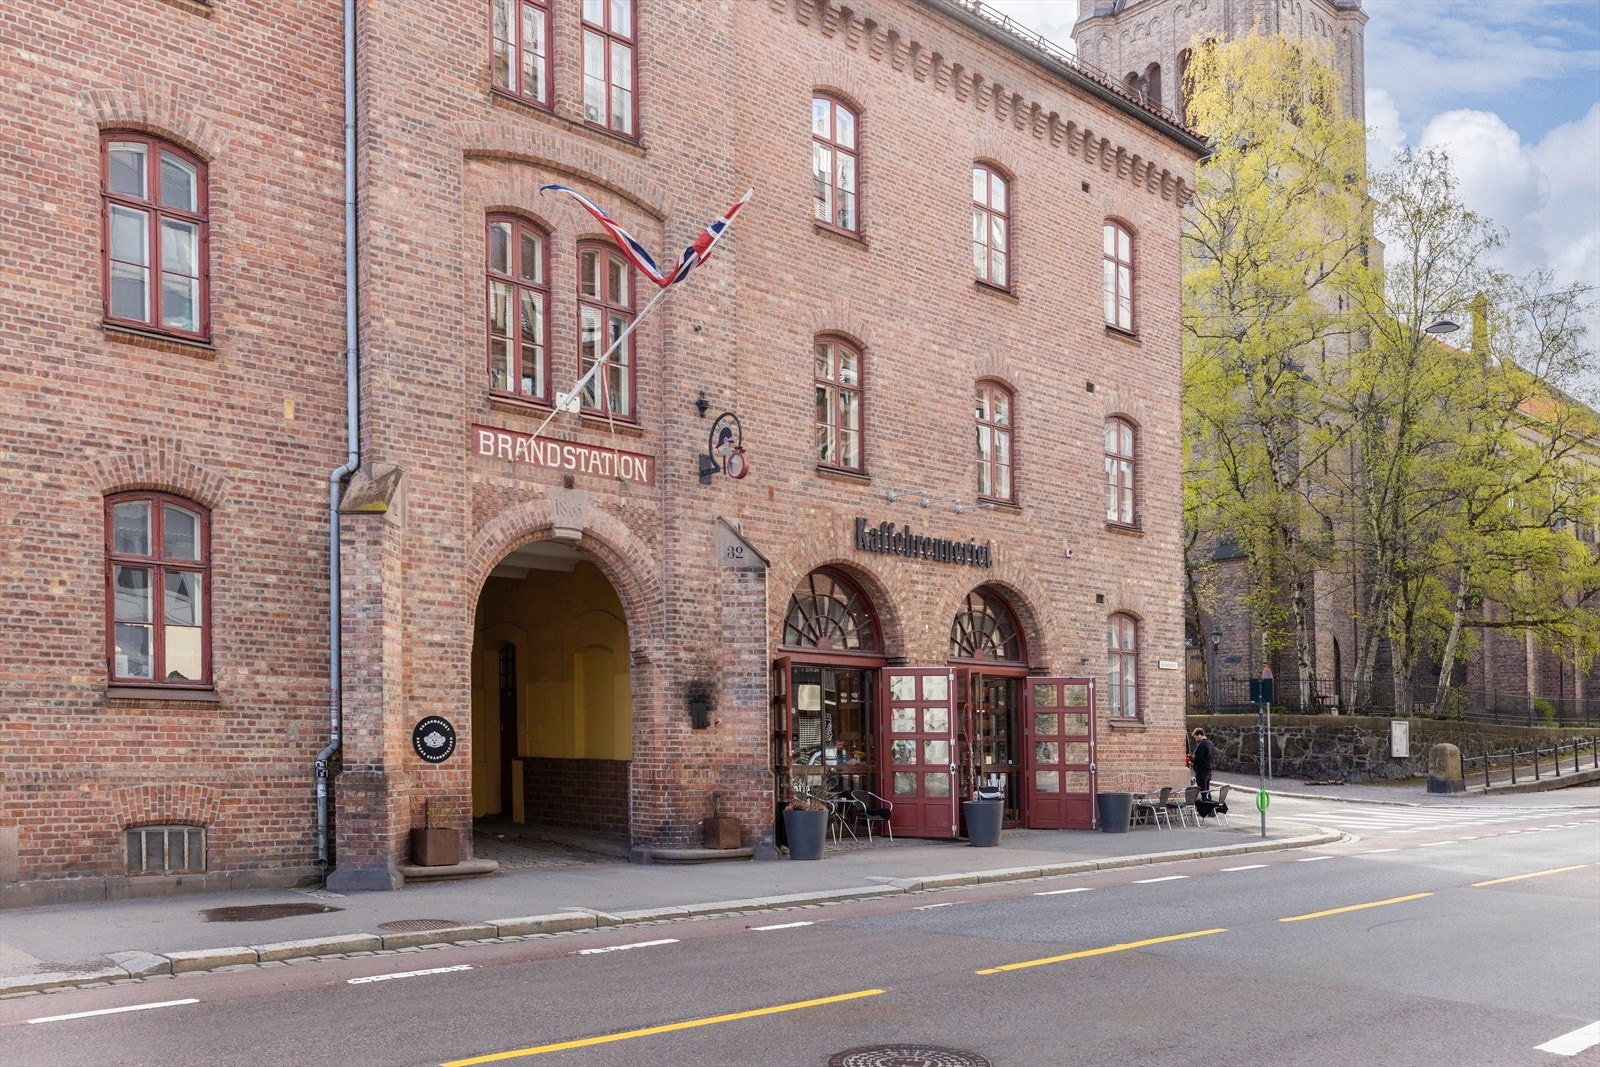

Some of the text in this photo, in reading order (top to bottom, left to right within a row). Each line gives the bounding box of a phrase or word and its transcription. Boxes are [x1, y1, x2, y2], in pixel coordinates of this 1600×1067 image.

[478, 430, 648, 483] BRANDSTATION
[727, 546, 744, 559] 32
[855, 516, 993, 568] Kaffebrenneriet
